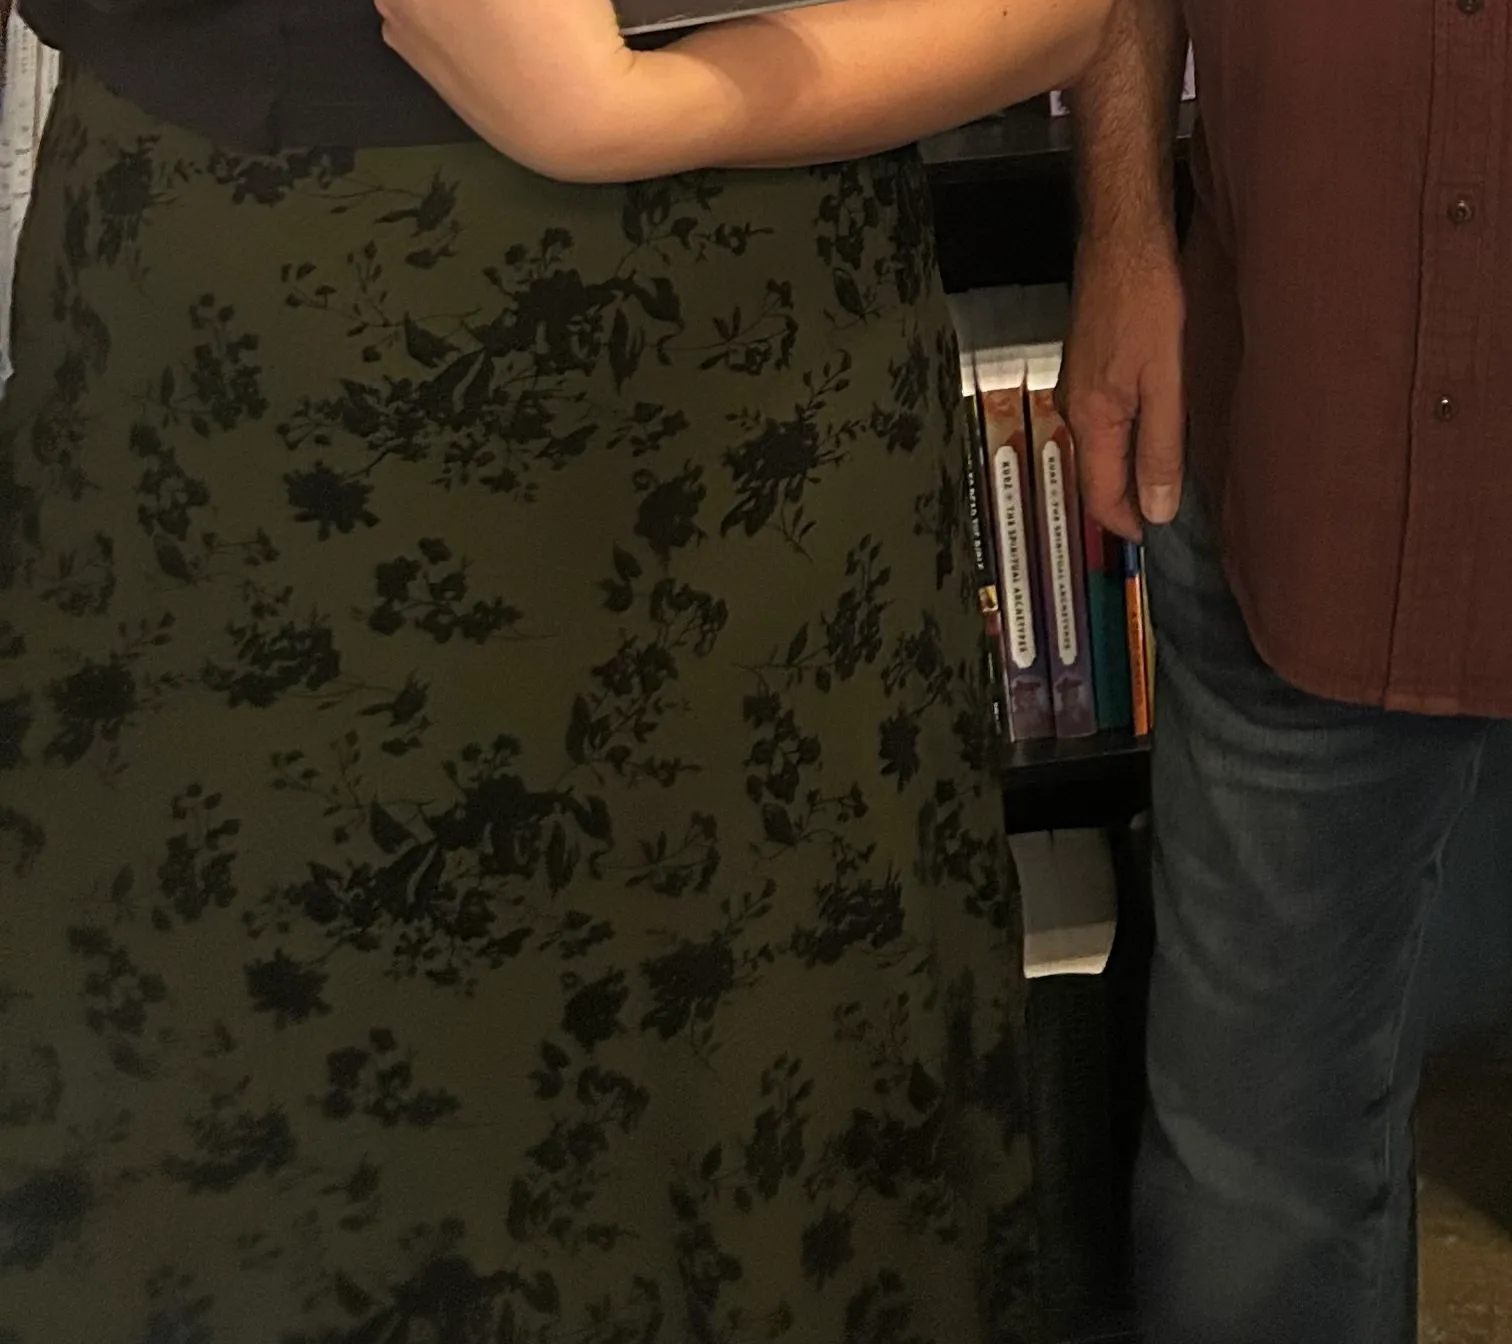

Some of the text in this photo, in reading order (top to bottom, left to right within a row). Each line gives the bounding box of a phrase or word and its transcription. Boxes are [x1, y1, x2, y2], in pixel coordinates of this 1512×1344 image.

[1002, 461, 1028, 653] KURZ THE SPIRITUAL ARCHETYPES
